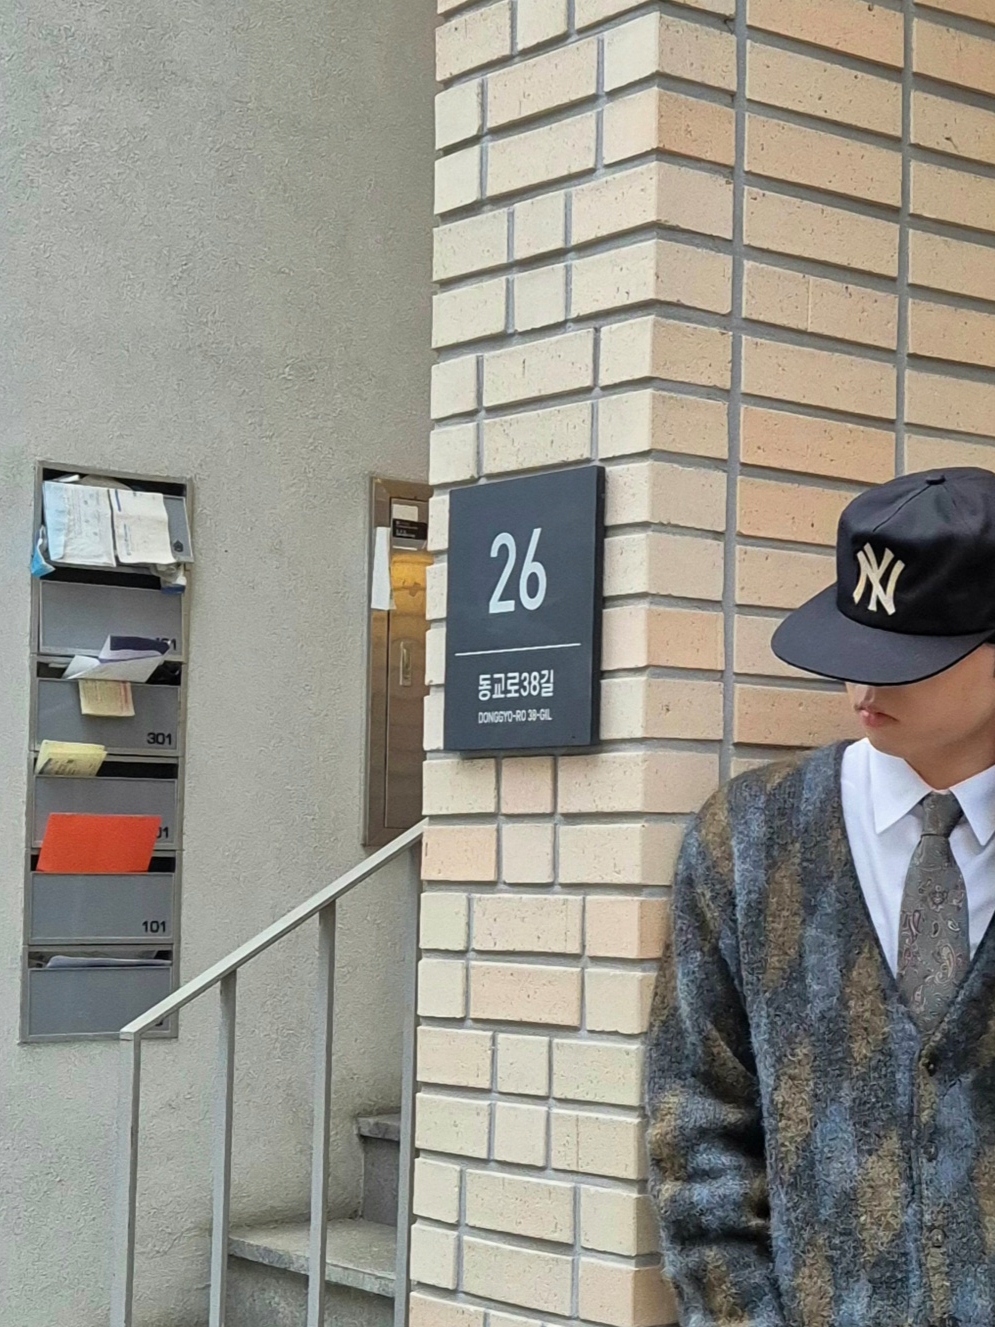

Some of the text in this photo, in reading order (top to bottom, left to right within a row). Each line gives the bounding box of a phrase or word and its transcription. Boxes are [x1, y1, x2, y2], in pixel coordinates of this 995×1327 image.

[489, 527, 547, 614] 26
[852, 542, 905, 616] NY
[478, 669, 554, 701] 동교로38길
[478, 709, 526, 724] DONGGYO-RO
[147, 732, 172, 745] 301
[142, 920, 166, 933] 101
